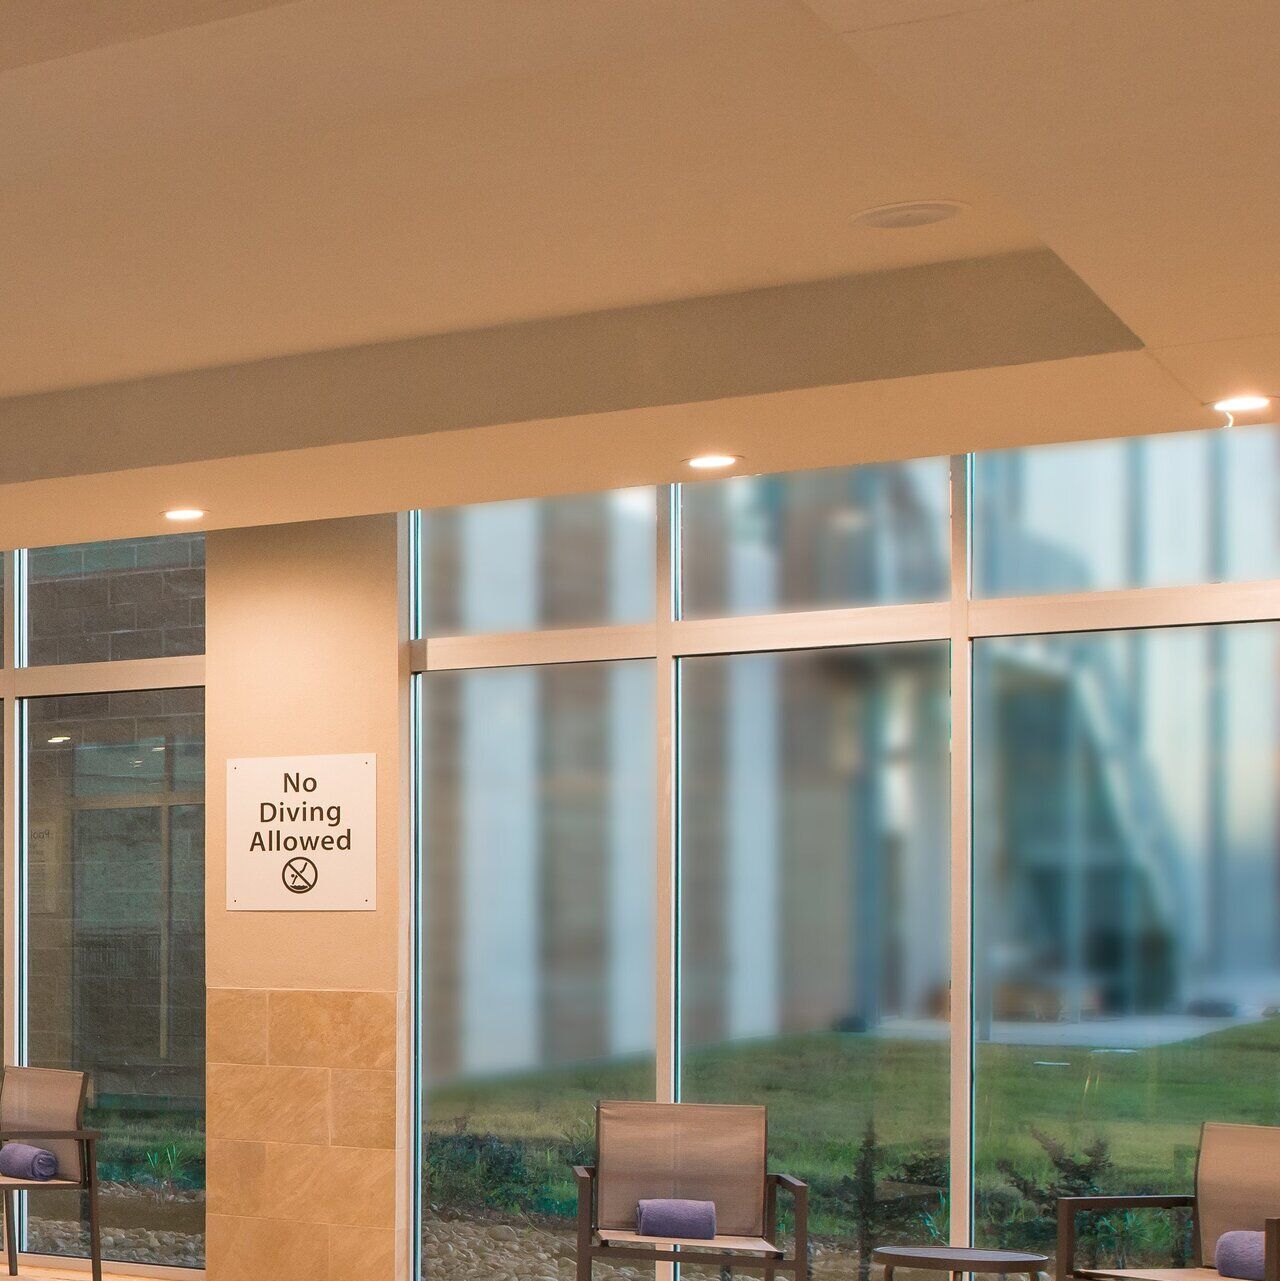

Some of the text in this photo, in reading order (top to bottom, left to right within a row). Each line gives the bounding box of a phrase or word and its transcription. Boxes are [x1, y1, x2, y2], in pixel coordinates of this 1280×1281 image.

[283, 772, 317, 793] No
[260, 801, 341, 827] Diving
[249, 828, 351, 852] Allowed
